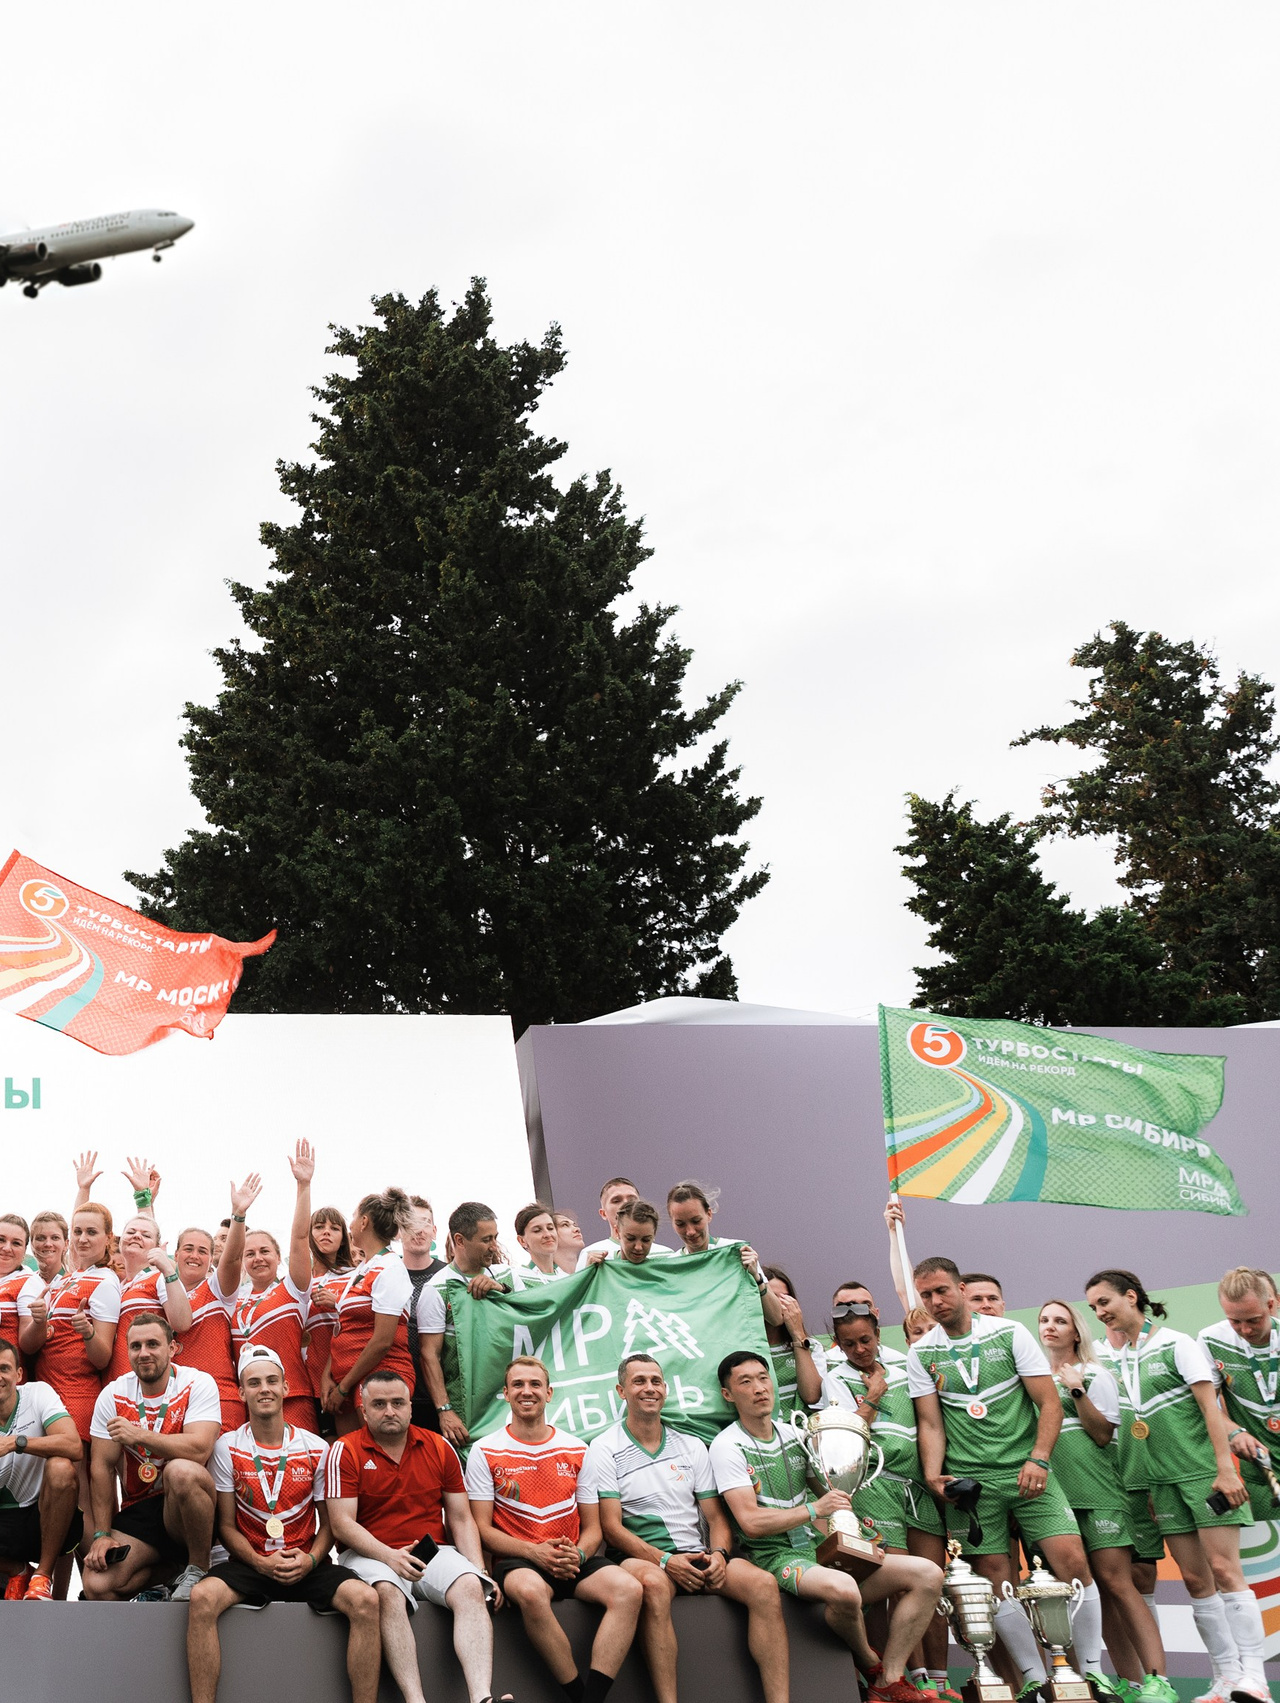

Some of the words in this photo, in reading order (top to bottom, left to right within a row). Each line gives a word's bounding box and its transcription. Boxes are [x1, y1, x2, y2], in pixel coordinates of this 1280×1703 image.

[101, 927, 115, 938] НА
[116, 932, 153, 953] РЕКОРД
[114, 970, 153, 992] МР
[156, 975, 240, 1006] МОСК
[971, 1037, 1144, 1075] ТУРБОСТРТЫ
[1011, 1062, 1027, 1072] НА
[1029, 1064, 1077, 1077] РЕКОРД
[1051, 1107, 1097, 1127] МР
[511, 1303, 613, 1372] МР
